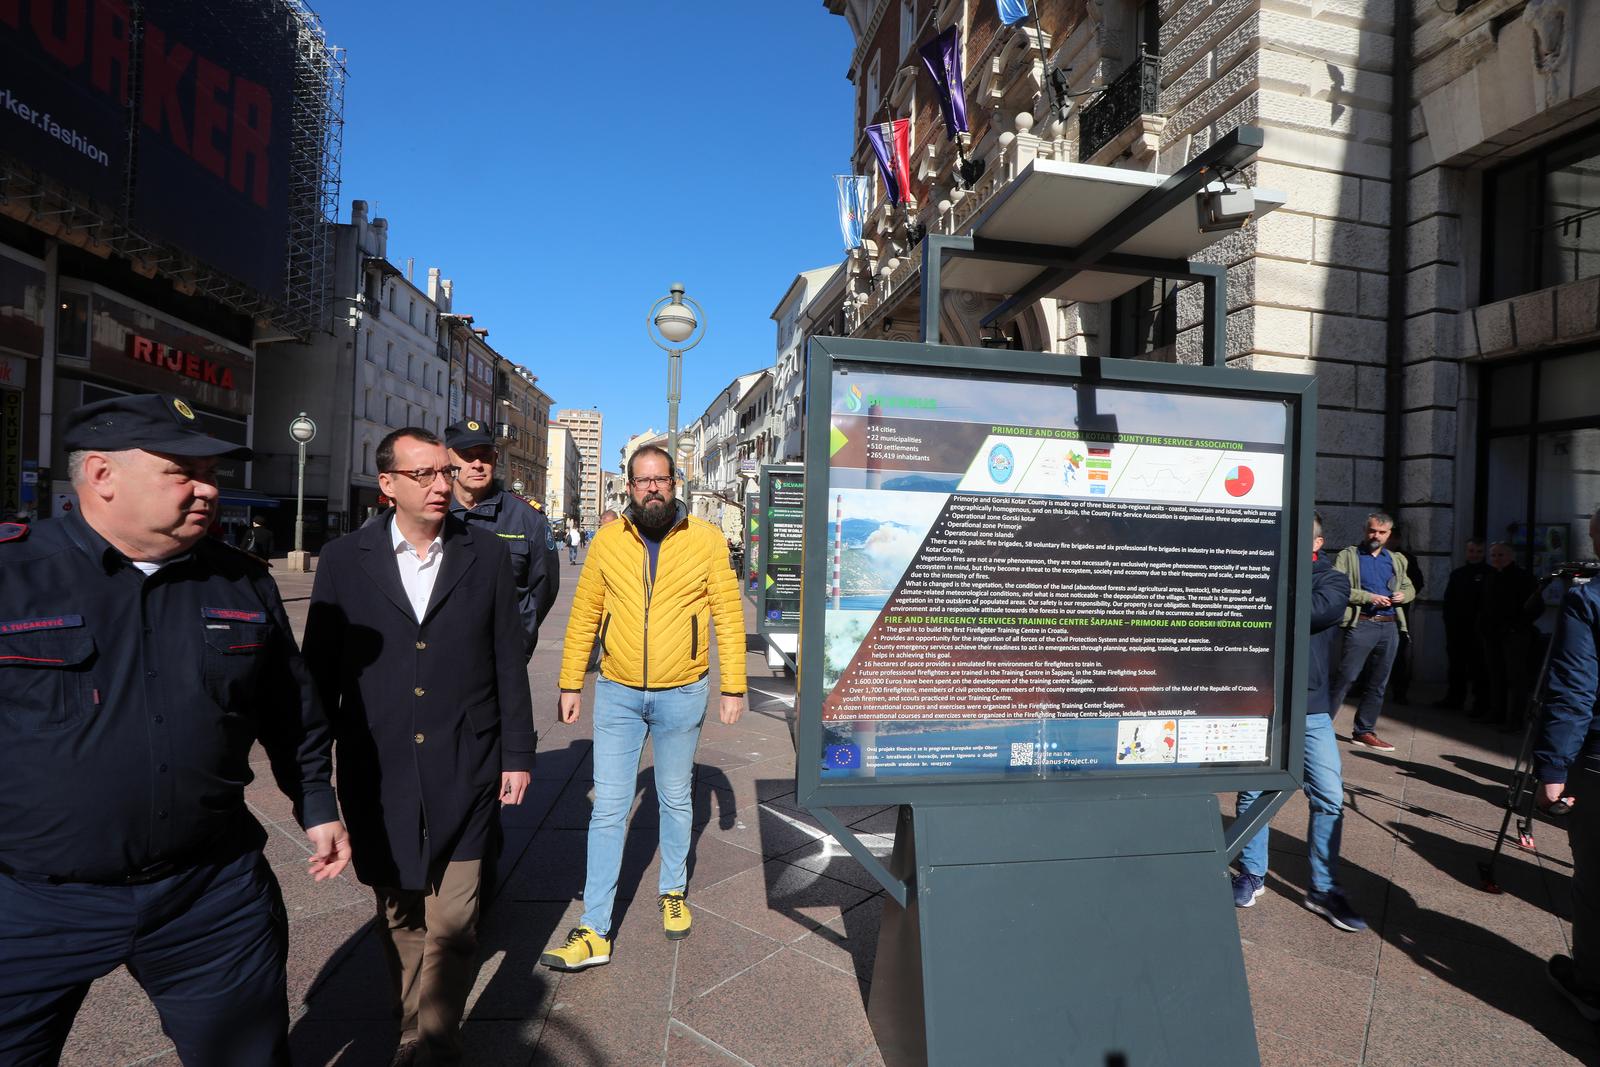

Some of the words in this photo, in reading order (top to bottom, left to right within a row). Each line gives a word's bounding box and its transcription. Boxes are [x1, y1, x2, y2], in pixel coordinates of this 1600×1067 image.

[133, 336, 235, 389] RIJEKA
[880, 435, 922, 444] municipalities
[992, 426, 1032, 435] PRIMORJE
[1035, 429, 1052, 437] AND
[1113, 434, 1144, 442] COUNTY
[1146, 436, 1161, 444] FIRE
[1164, 438, 1193, 446] SERVICE
[1195, 440, 1243, 449] ASSOCIATION
[884, 444, 919, 452] settlements
[870, 452, 895, 460] 265,419
[896, 453, 930, 461] inhabitants
[951, 512, 986, 521] Operational
[947, 520, 981, 529] Operational
[997, 522, 1022, 531] Primorje
[944, 529, 978, 538] Operational
[942, 547, 964, 555] County.
[968, 539, 986, 547] public
[998, 540, 1024, 548] brigades,
[1033, 541, 1060, 549] voluntary
[1071, 543, 1095, 551] brigades
[1115, 544, 1147, 552] professional
[1158, 546, 1180, 554] brigades
[1187, 547, 1209, 555] industry
[1225, 548, 1248, 556] Primorje
[942, 572, 967, 580] intensity
[884, 615, 902, 623] FIRE
[925, 616, 976, 624] EMERGENCY
[979, 617, 1016, 625] SERVICES
[1018, 617, 1057, 625] TRAINING
[1059, 618, 1088, 626] CENTRE
[1091, 617, 1123, 626] ŠAPJANE
[1131, 619, 1169, 627] PRIMORJE
[1188, 620, 1216, 628] GORSKI
[997, 627, 1020, 635] Training
[871, 651, 888, 659] helps
[896, 651, 924, 660] achieving
[937, 652, 952, 660] goal.
[925, 660, 951, 668] provides
[1071, 677, 1094, 685] Šapjane.
[842, 695, 860, 703] youth
[861, 695, 886, 703] firemen,
[968, 694, 991, 702] Training
